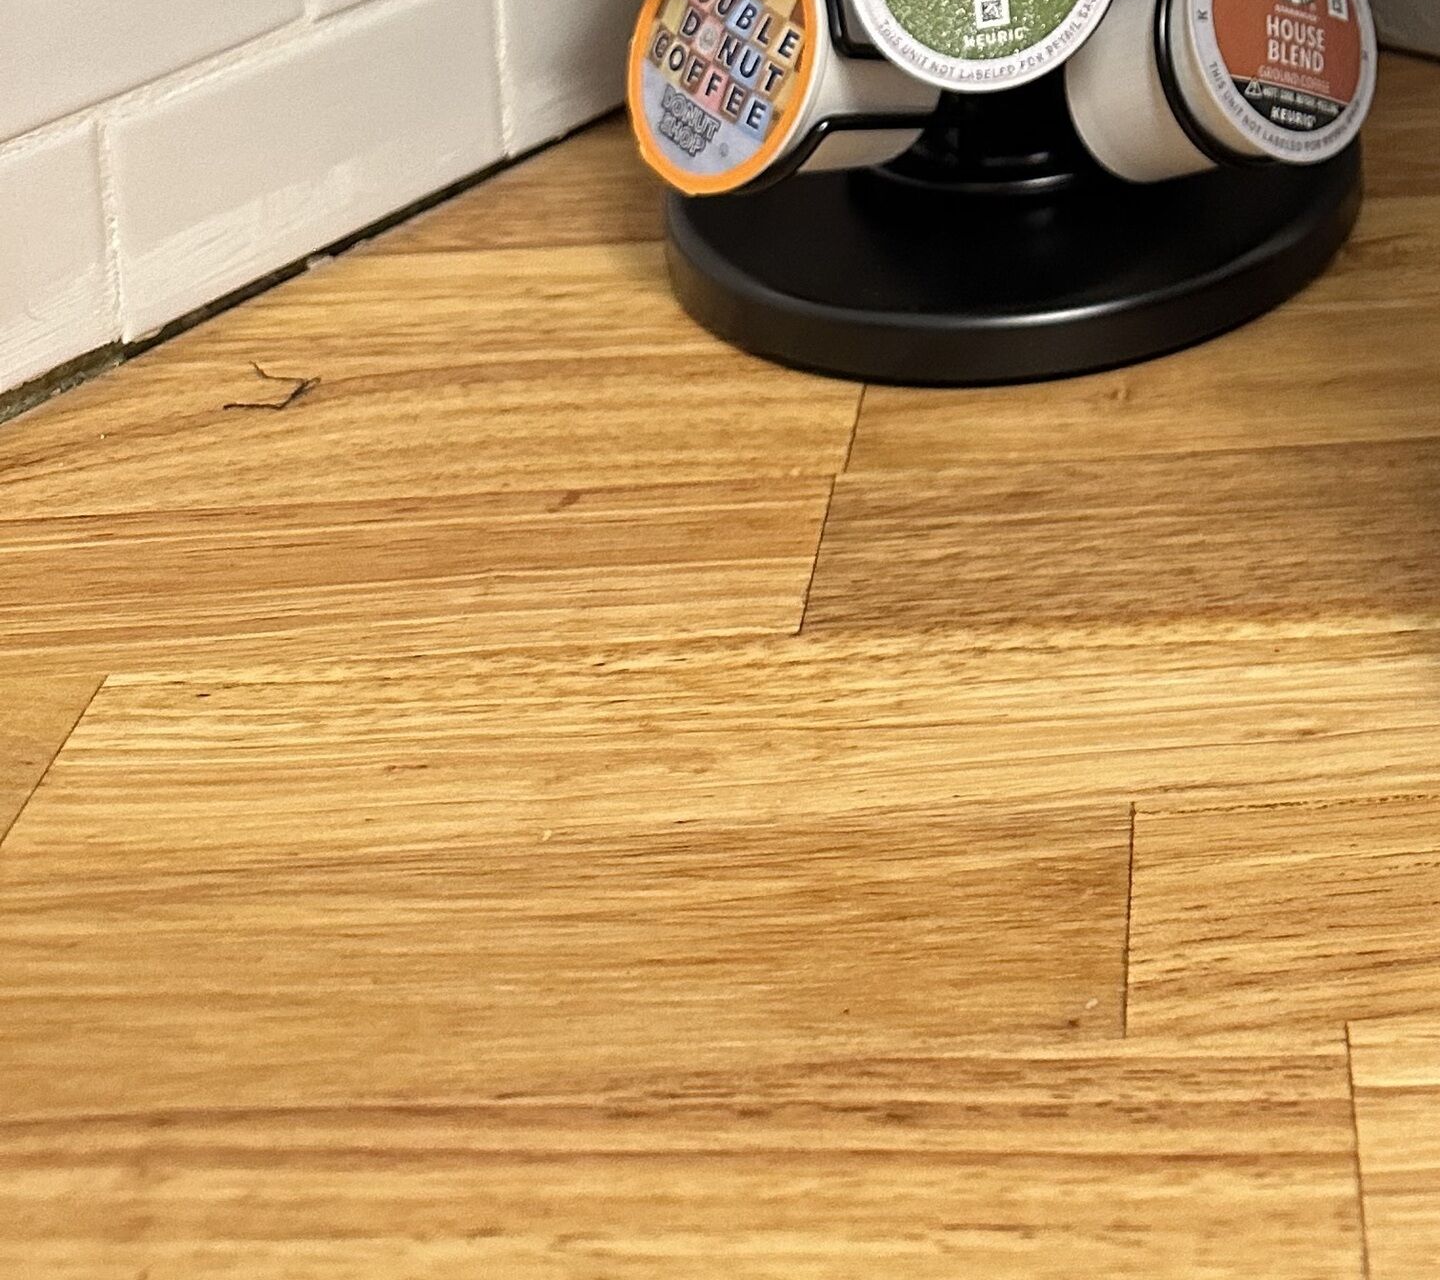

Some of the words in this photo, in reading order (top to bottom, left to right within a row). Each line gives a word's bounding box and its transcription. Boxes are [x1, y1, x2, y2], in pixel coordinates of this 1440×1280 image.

[681, 6, 785, 93] DONUT
[962, 27, 1024, 48] KEURIG
[1266, 14, 1326, 51] HOUSE
[902, 42, 928, 66] UNIT
[1267, 41, 1325, 73] BLEND
[652, 27, 768, 133] COFFEE
